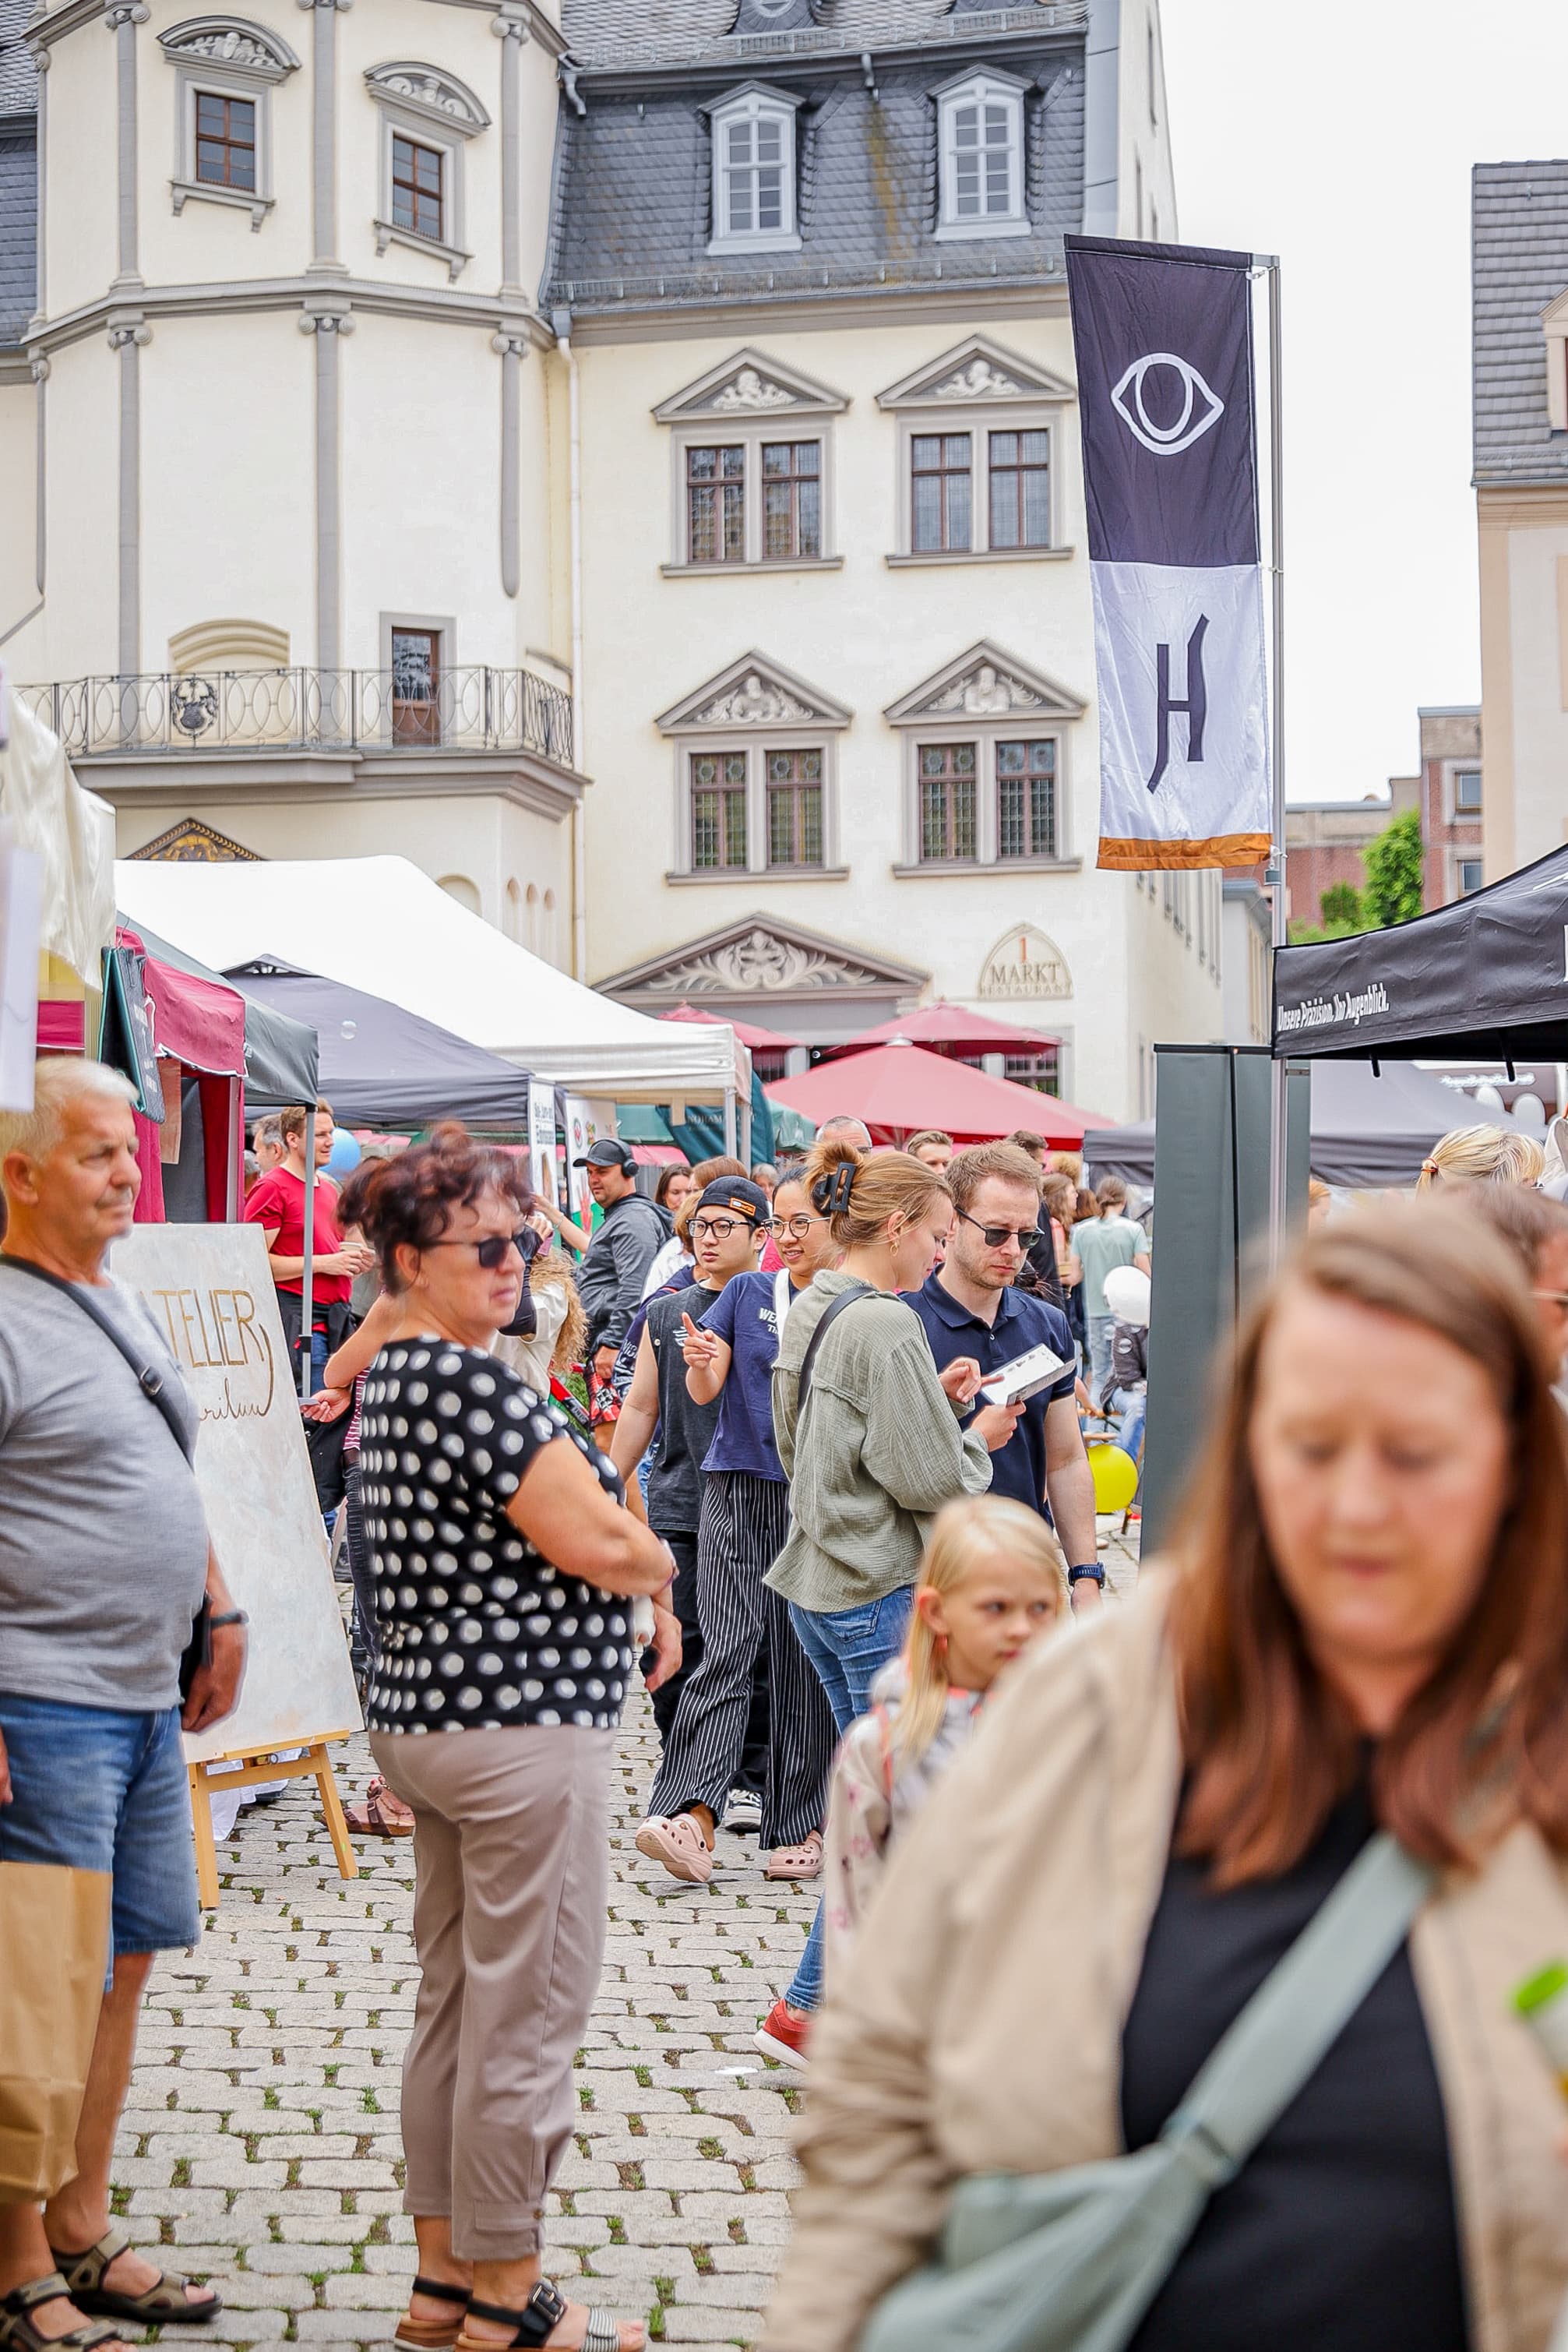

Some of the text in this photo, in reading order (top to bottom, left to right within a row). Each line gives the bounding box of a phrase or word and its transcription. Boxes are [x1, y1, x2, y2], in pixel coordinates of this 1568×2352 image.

[990, 961, 1061, 982] MARKT
[1277, 982, 1390, 1031] Unsere Präzision. Ihr Augenblick.
[143, 1289, 265, 1368] TELIER
